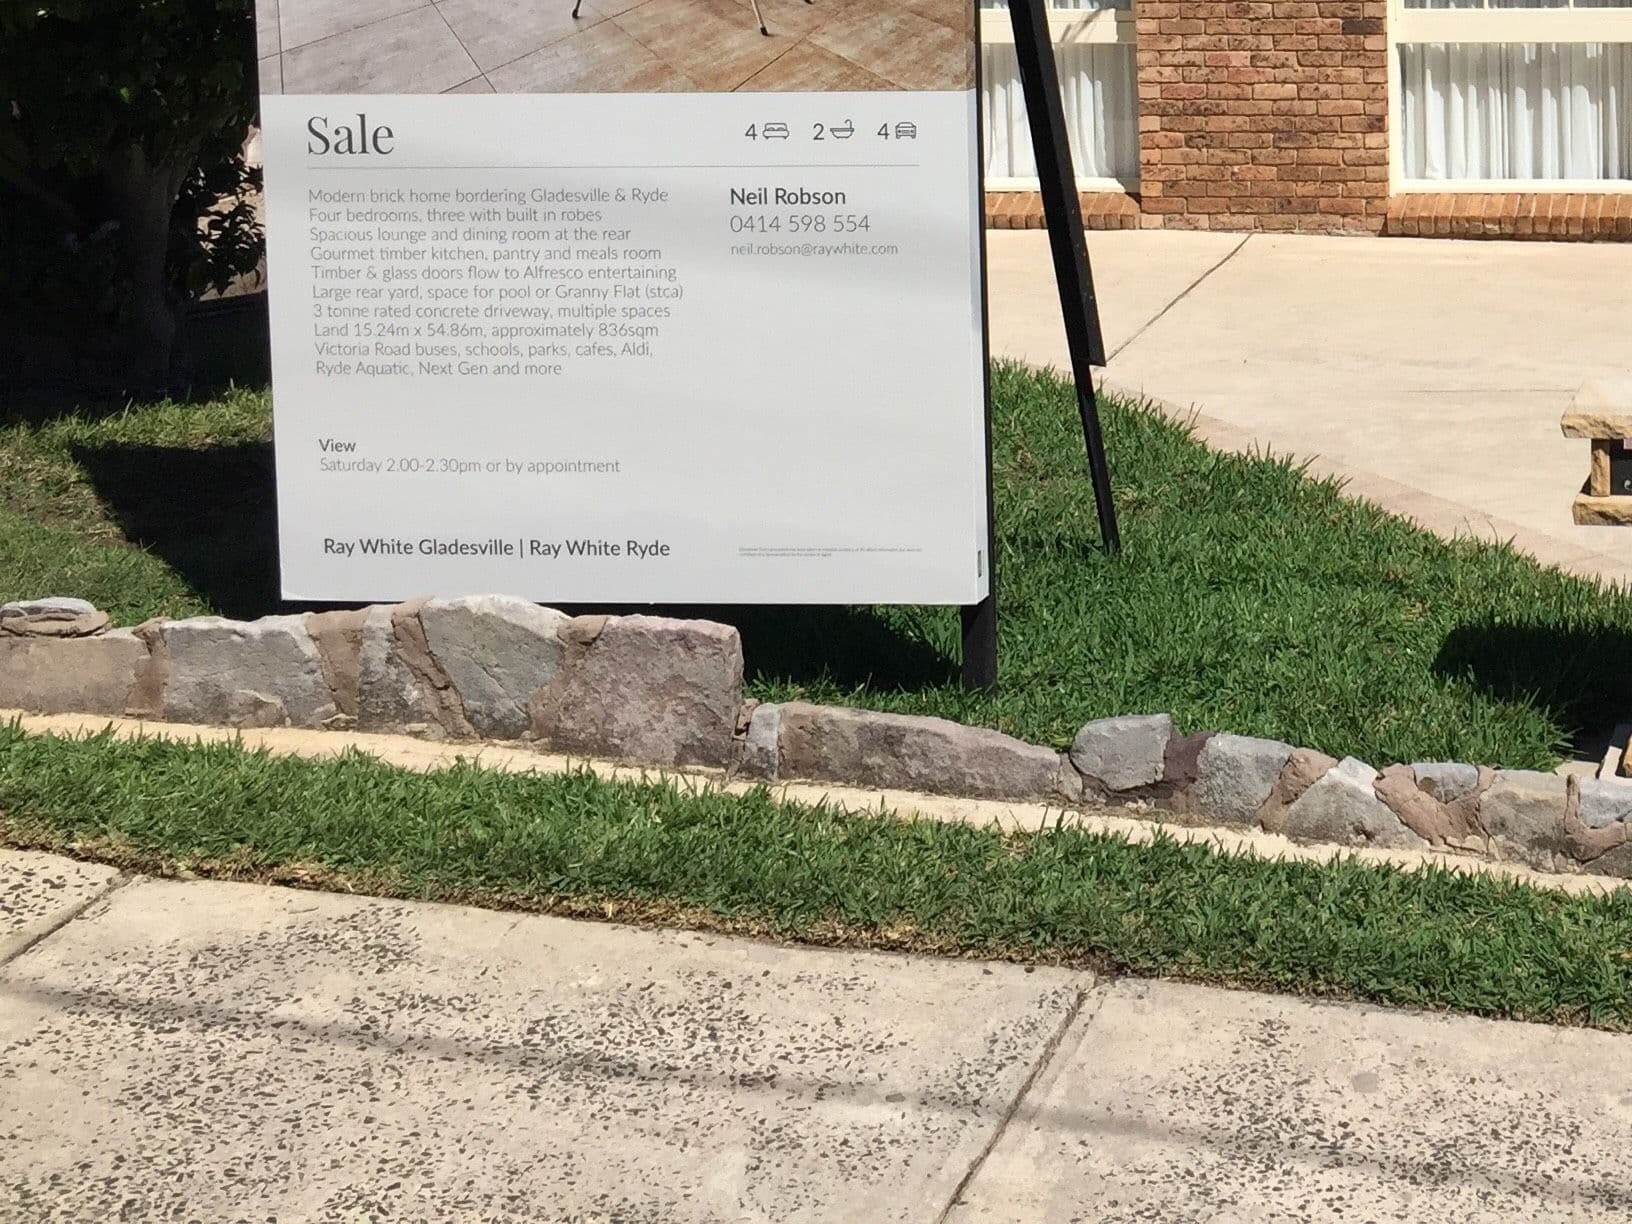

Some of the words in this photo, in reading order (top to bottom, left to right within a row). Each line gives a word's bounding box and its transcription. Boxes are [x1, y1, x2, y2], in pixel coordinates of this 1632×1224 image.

[307, 114, 395, 156] Sale
[744, 124, 757, 140] 4
[813, 123, 824, 140] 2
[877, 123, 890, 140] 4
[308, 189, 366, 204] Modern
[369, 189, 405, 203] brick
[409, 189, 451, 203] home
[455, 188, 526, 206] bordering
[530, 188, 610, 203] Gladesville
[614, 188, 626, 202] &
[631, 188, 669, 205] Ryde
[730, 188, 767, 205] Neil
[775, 188, 846, 205] Robson
[309, 208, 342, 223] Four
[346, 208, 422, 224] bedrooms,
[426, 208, 466, 222] three
[469, 208, 502, 222] with
[506, 208, 539, 222] built
[543, 209, 556, 222] in
[561, 208, 602, 222] robes
[730, 215, 781, 233] 0414
[789, 215, 826, 232] 598
[833, 215, 870, 232] 554
[310, 227, 373, 245] Spacious
[377, 227, 427, 244] lounge
[431, 227, 458, 242] and
[462, 227, 508, 244] dining
[512, 230, 550, 241] room
[554, 228, 570, 241] at
[574, 227, 598, 241] the
[602, 229, 631, 241] rear
[310, 246, 375, 261] Gourmet
[379, 246, 427, 260] timber
[432, 246, 489, 262] kitchen,
[493, 247, 540, 263] pantry
[544, 246, 572, 260] and
[576, 246, 619, 260] meals
[622, 248, 662, 260] room
[730, 243, 898, 256] neil.robson@raywhite.com
[311, 265, 362, 281] Timber
[366, 266, 378, 280] &
[382, 265, 417, 283] glass
[422, 265, 464, 280] doors
[467, 265, 499, 280] flow
[504, 266, 519, 279] to
[523, 265, 584, 279] Alfresco
[588, 265, 677, 282] entertaining
[312, 285, 351, 302] Large
[356, 287, 383, 300] rear
[387, 285, 424, 302] yard,
[428, 287, 469, 302] space
[473, 284, 495, 299] for
[499, 284, 531, 302] pool
[535, 286, 551, 299] or
[555, 285, 608, 302] Granny
[613, 284, 641, 299] Flat
[645, 284, 684, 301] (stca)
[313, 305, 323, 318] 3
[327, 305, 370, 318] tonne
[374, 304, 411, 318] rated
[415, 304, 480, 318] concrete
[483, 304, 554, 321] driveway,
[558, 303, 617, 321] multiple
[621, 305, 671, 320] spaces
[314, 324, 349, 338] Land
[354, 324, 410, 338] 15.24m
[414, 326, 422, 337] x
[426, 323, 487, 339] 54.86m,
[491, 322, 594, 340] approximately
[598, 322, 659, 340] 836sqm
[315, 342, 370, 357] Victoria
[375, 342, 411, 357] Road
[415, 342, 461, 358] buses,
[465, 341, 523, 358] schools,
[528, 341, 571, 359] parks,
[575, 341, 617, 357] cafes,
[621, 341, 653, 357] Aldi,
[316, 362, 352, 377] Ryde
[356, 361, 414, 377] Aquatic,
[419, 361, 454, 376] Next
[458, 361, 488, 376] Gen
[492, 361, 520, 376] and
[524, 363, 562, 375] more
[318, 438, 356, 453] View
[319, 457, 382, 475] Saturday
[486, 460, 501, 473] or
[506, 457, 523, 475] by
[527, 457, 621, 475] appointment
[323, 538, 356, 560] Ray
[360, 537, 414, 556] White
[418, 537, 514, 557] Gladesville
[529, 538, 562, 560] Ray
[565, 537, 621, 557] White
[626, 538, 671, 559] Ryde
